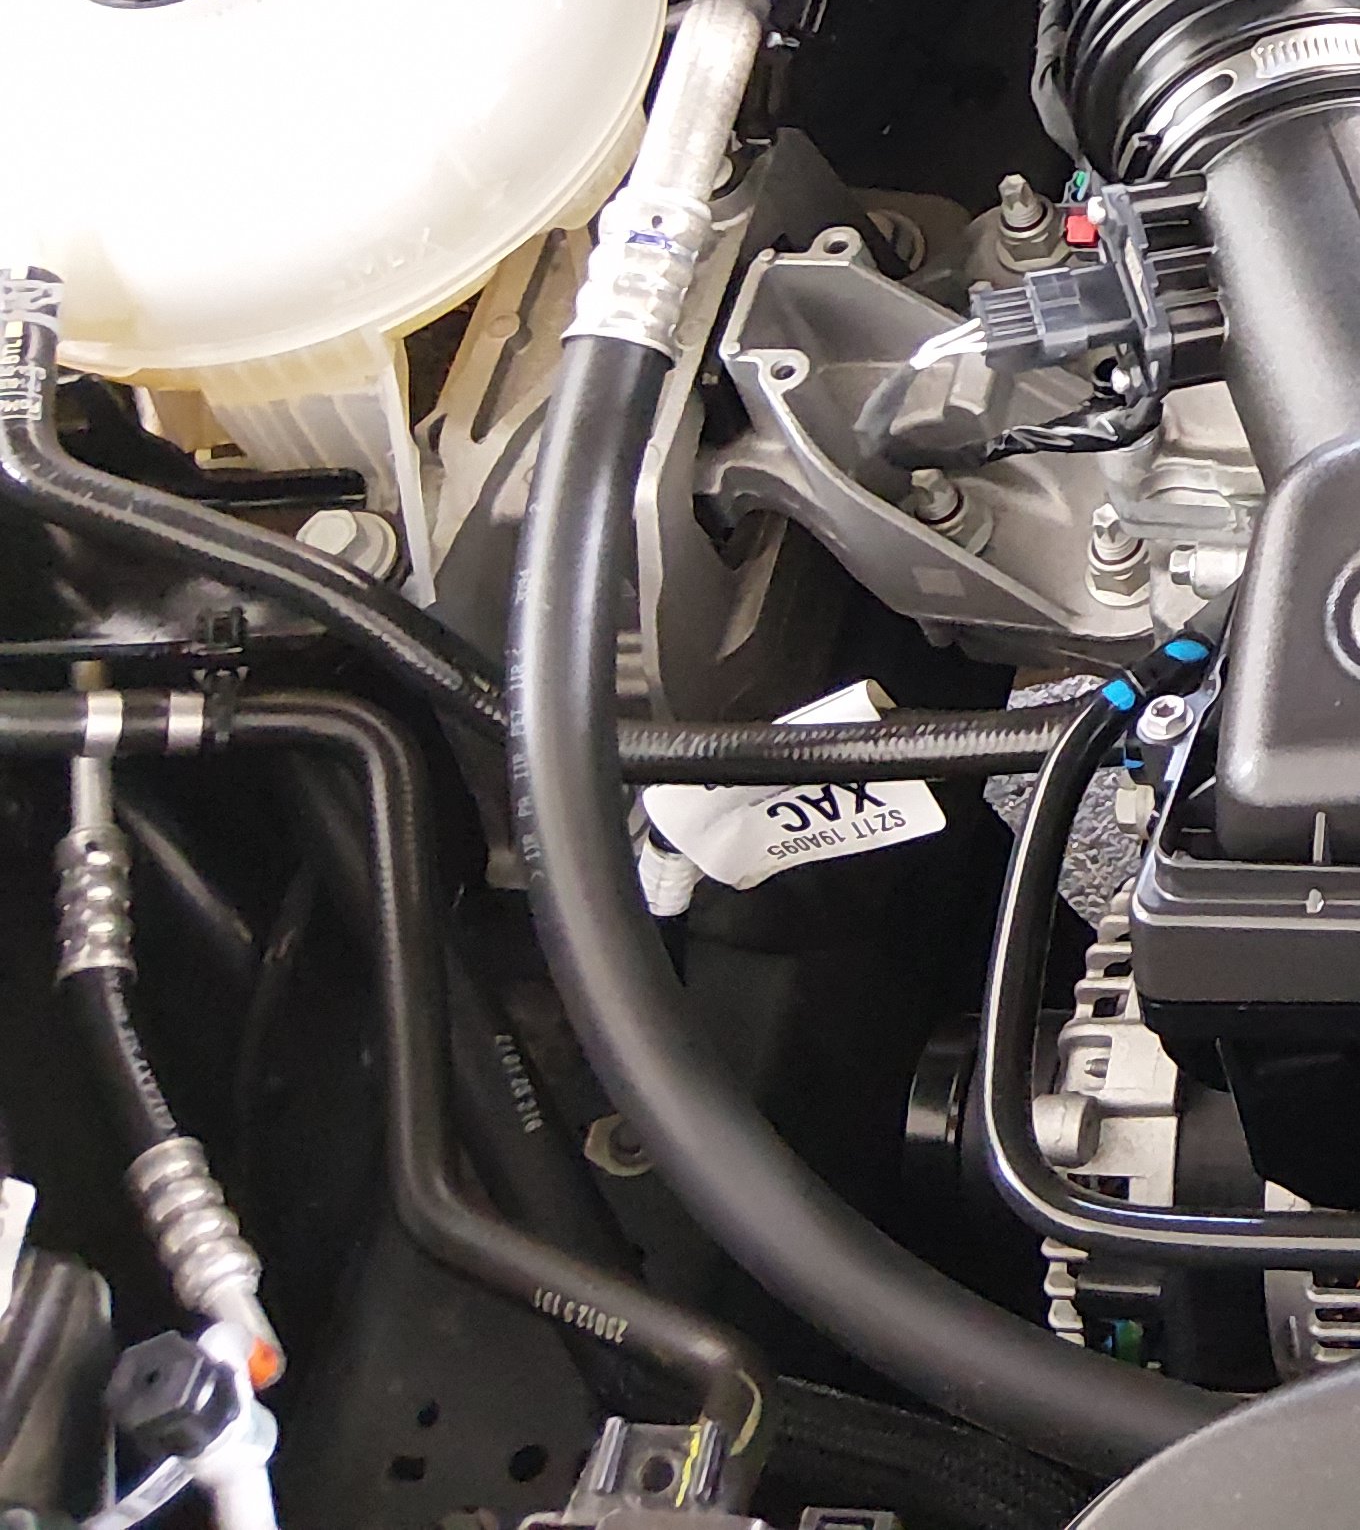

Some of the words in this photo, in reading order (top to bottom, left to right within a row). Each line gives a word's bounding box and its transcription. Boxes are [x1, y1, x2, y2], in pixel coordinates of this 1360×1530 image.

[766, 781, 887, 833] XAC
[848, 808, 907, 839] SZ1T
[766, 826, 846, 861] 19A095
